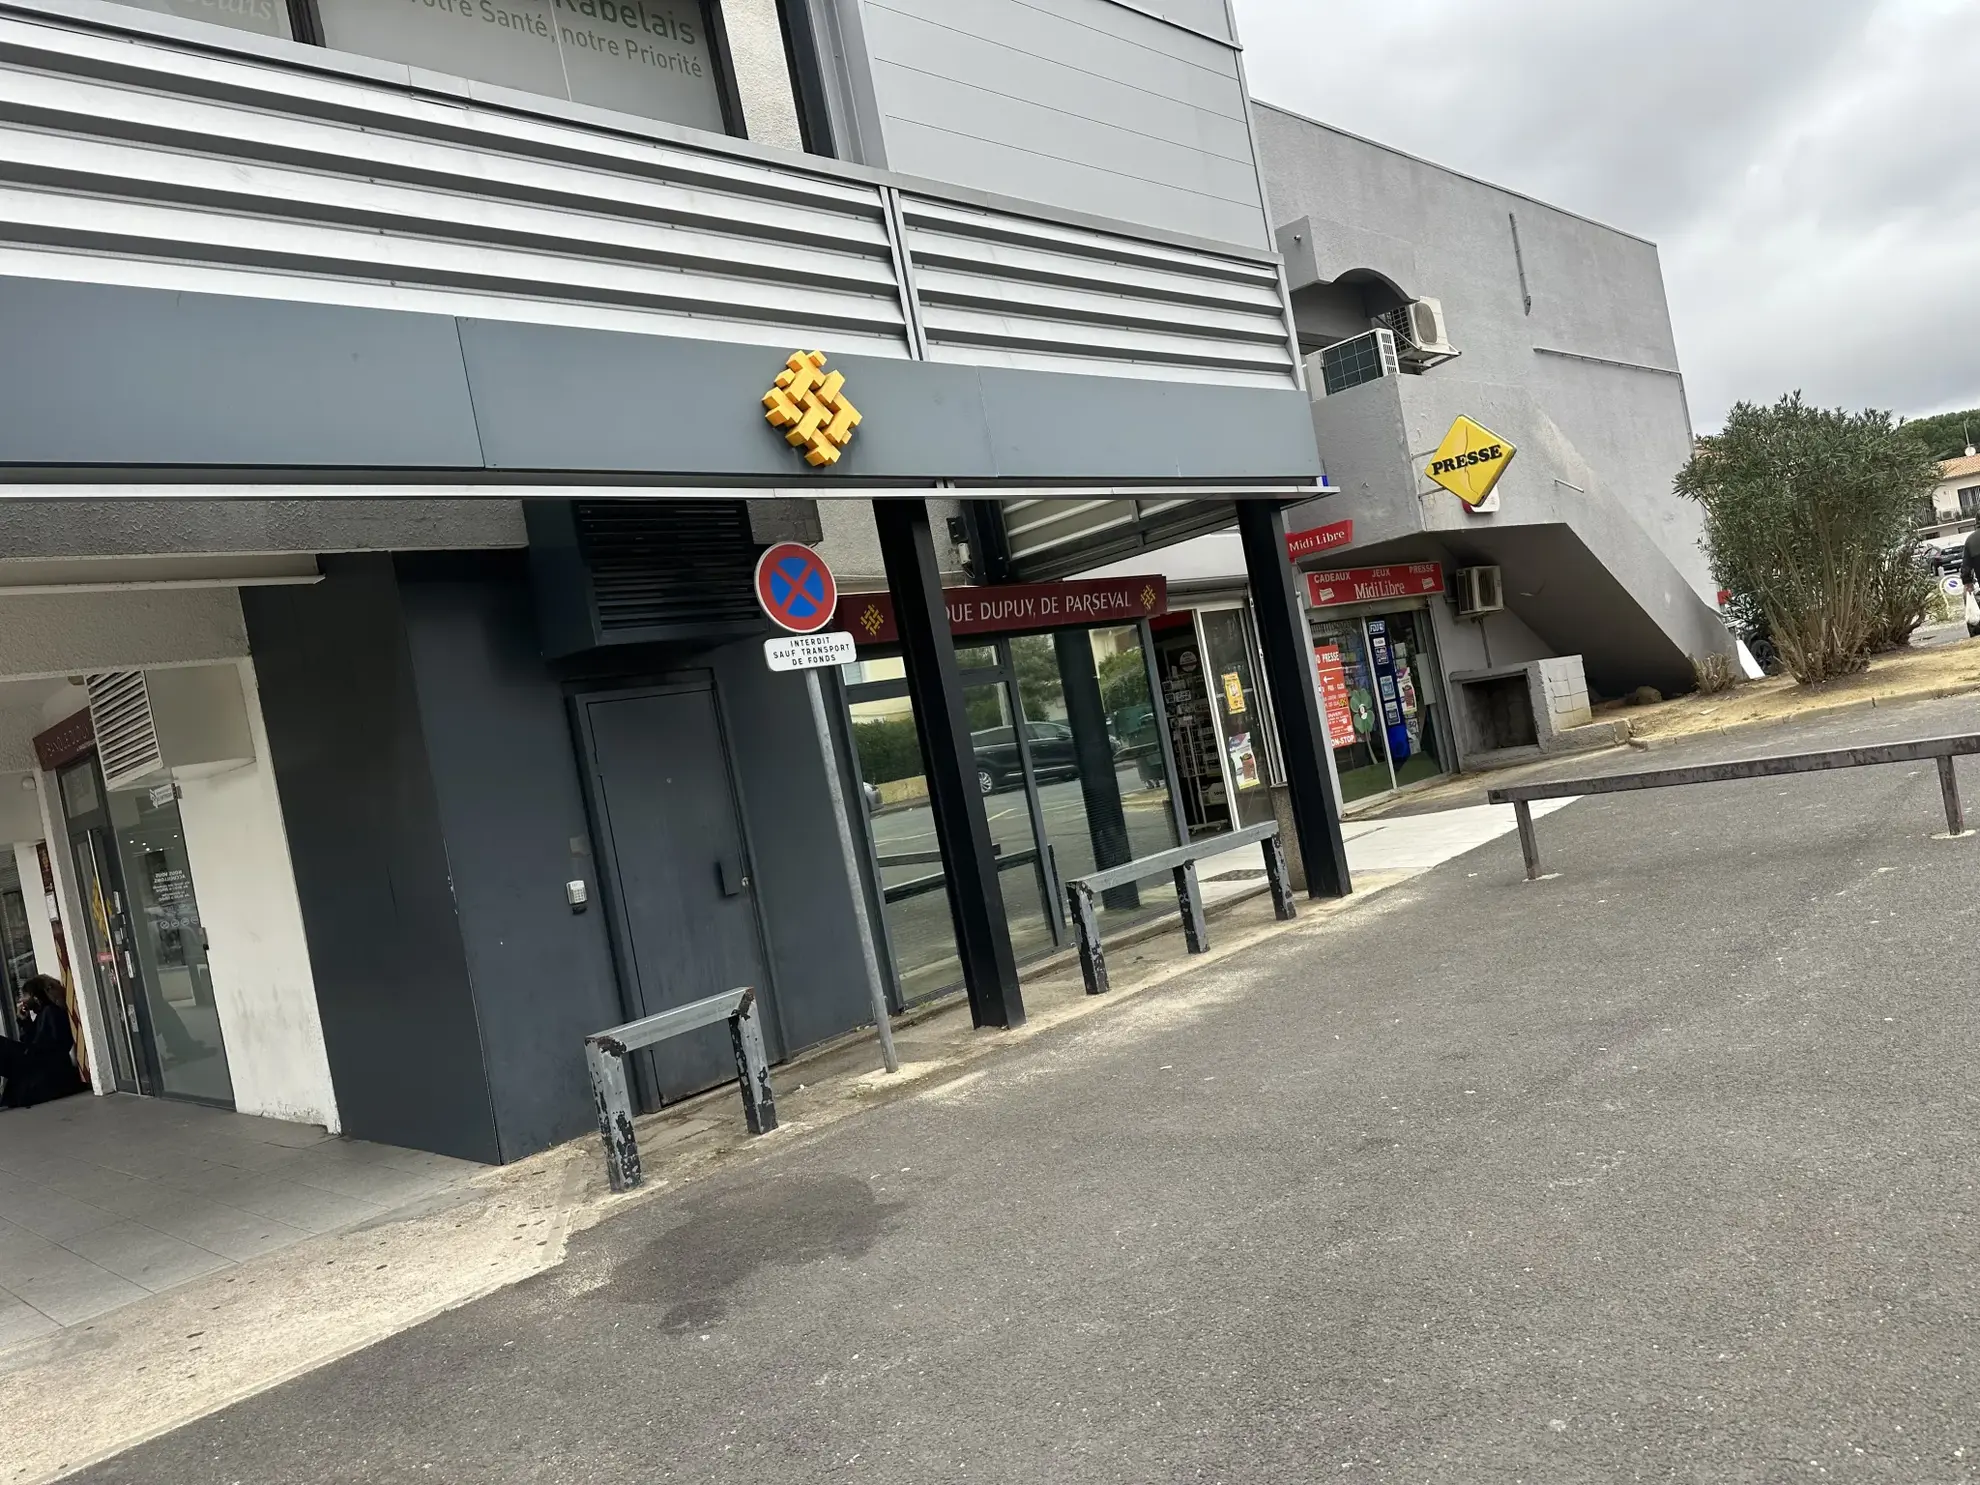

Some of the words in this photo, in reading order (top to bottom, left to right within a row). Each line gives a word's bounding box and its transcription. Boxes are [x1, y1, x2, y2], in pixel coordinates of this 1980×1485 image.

[561, 25, 620, 56] notre
[625, 38, 704, 78] Priorité
[1431, 444, 1503, 475] PRESSE
[1288, 538, 1314, 552] Midi
[1316, 531, 1346, 546] Libre
[1314, 571, 1351, 584] CADEAUX
[1372, 568, 1391, 577] JEUX
[1409, 564, 1434, 573] PRESSE
[1041, 597, 1060, 615] DE
[1066, 591, 1130, 616] PARSEVAL
[773, 649, 796, 659] SAUF
[801, 643, 850, 656] TRANSPORT
[790, 636, 830, 648] INTERDIT
[792, 657, 804, 666] DE
[808, 654, 836, 664] FONDS
